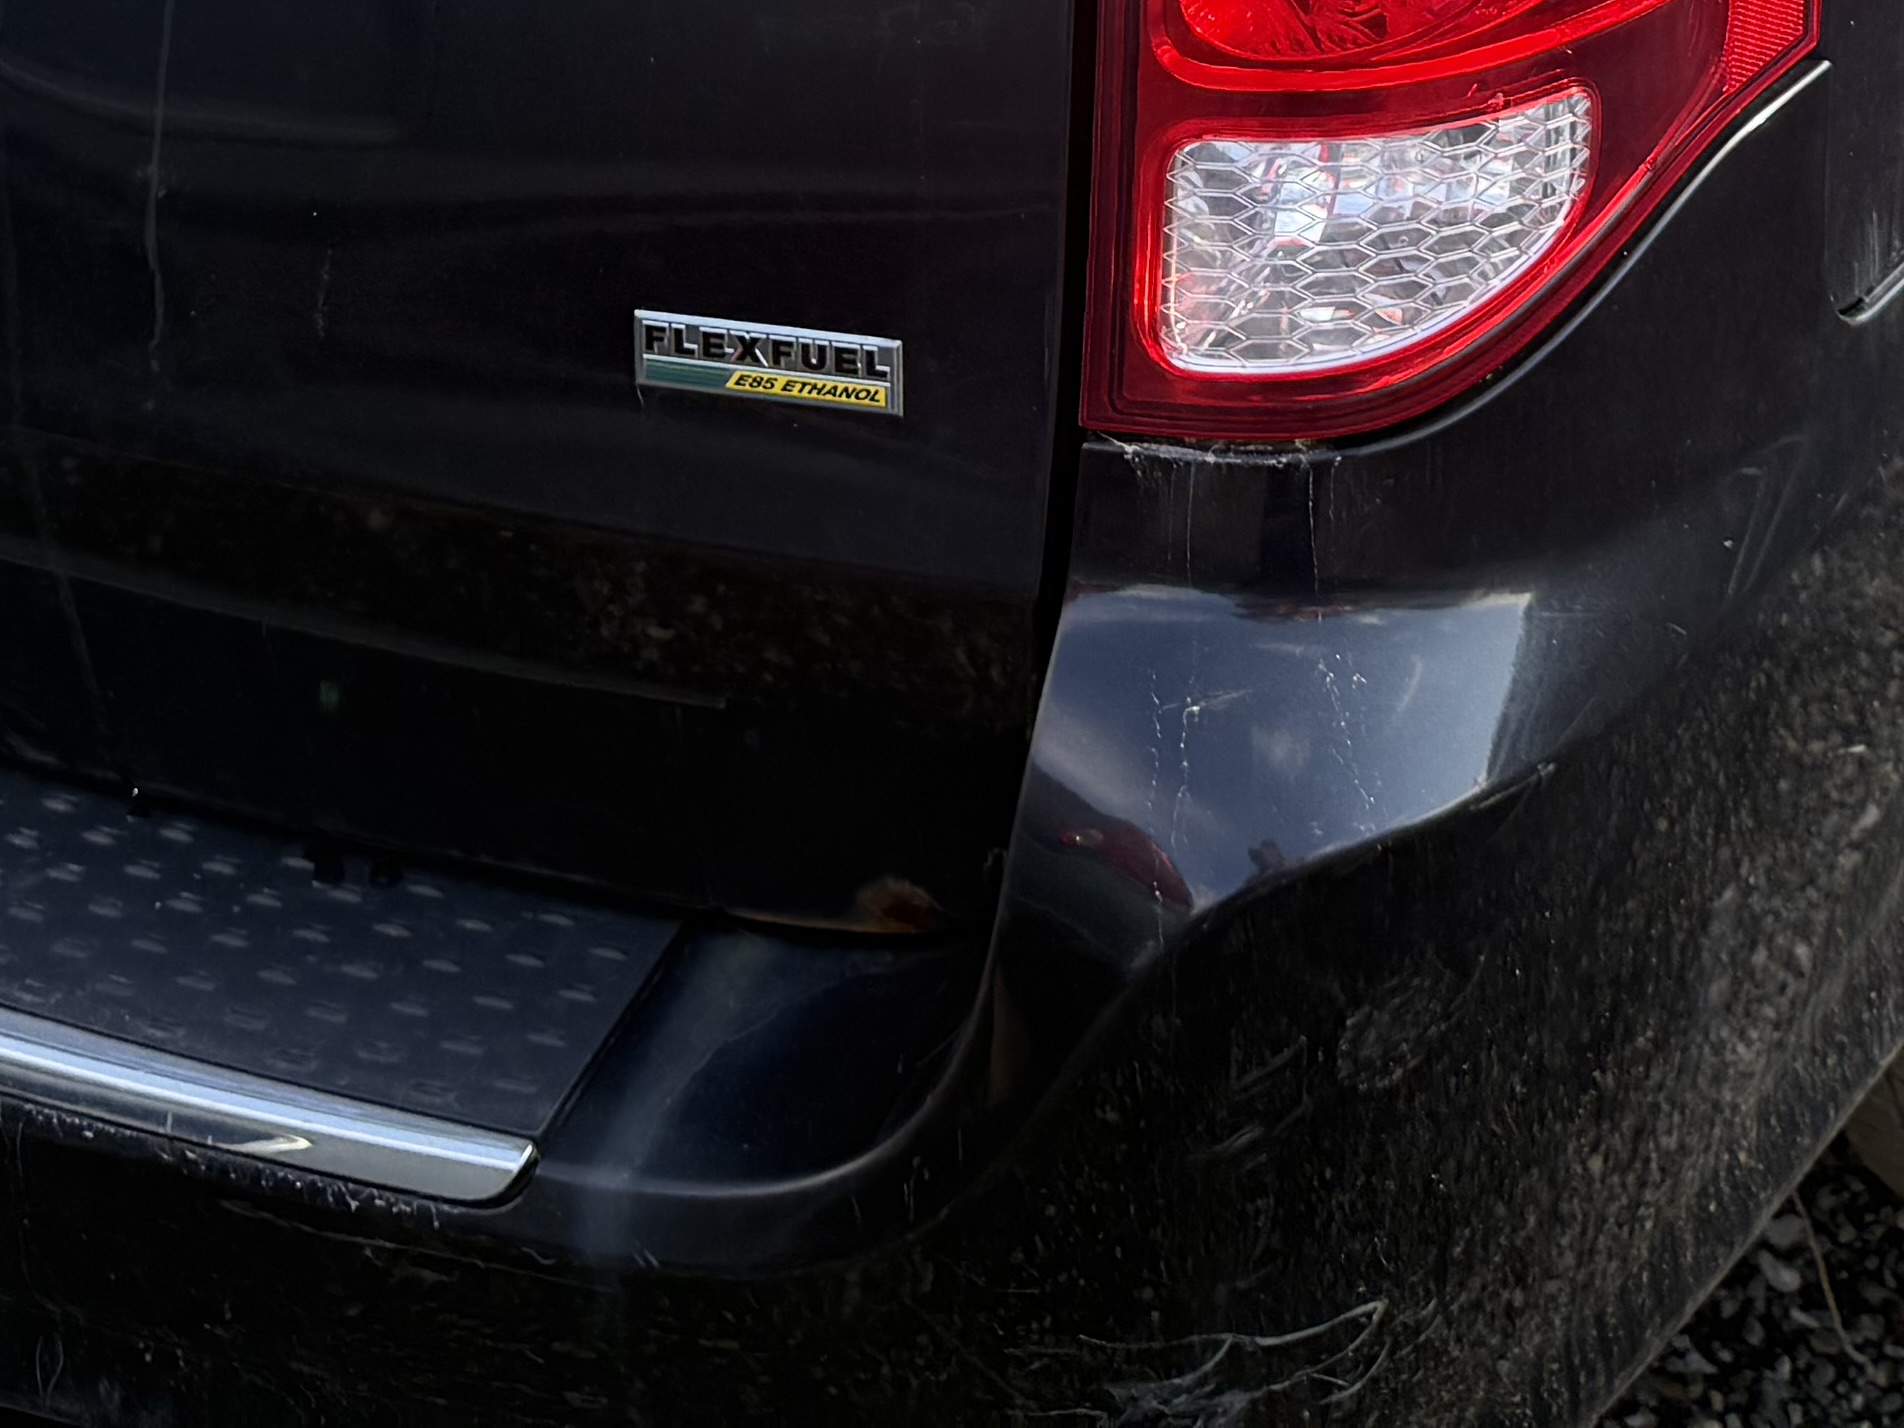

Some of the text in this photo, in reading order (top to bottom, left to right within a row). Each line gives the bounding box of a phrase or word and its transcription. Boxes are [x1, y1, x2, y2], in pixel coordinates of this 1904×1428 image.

[642, 320, 891, 378] FLEXFUEL
[734, 373, 882, 403] E85 ETHANOL
